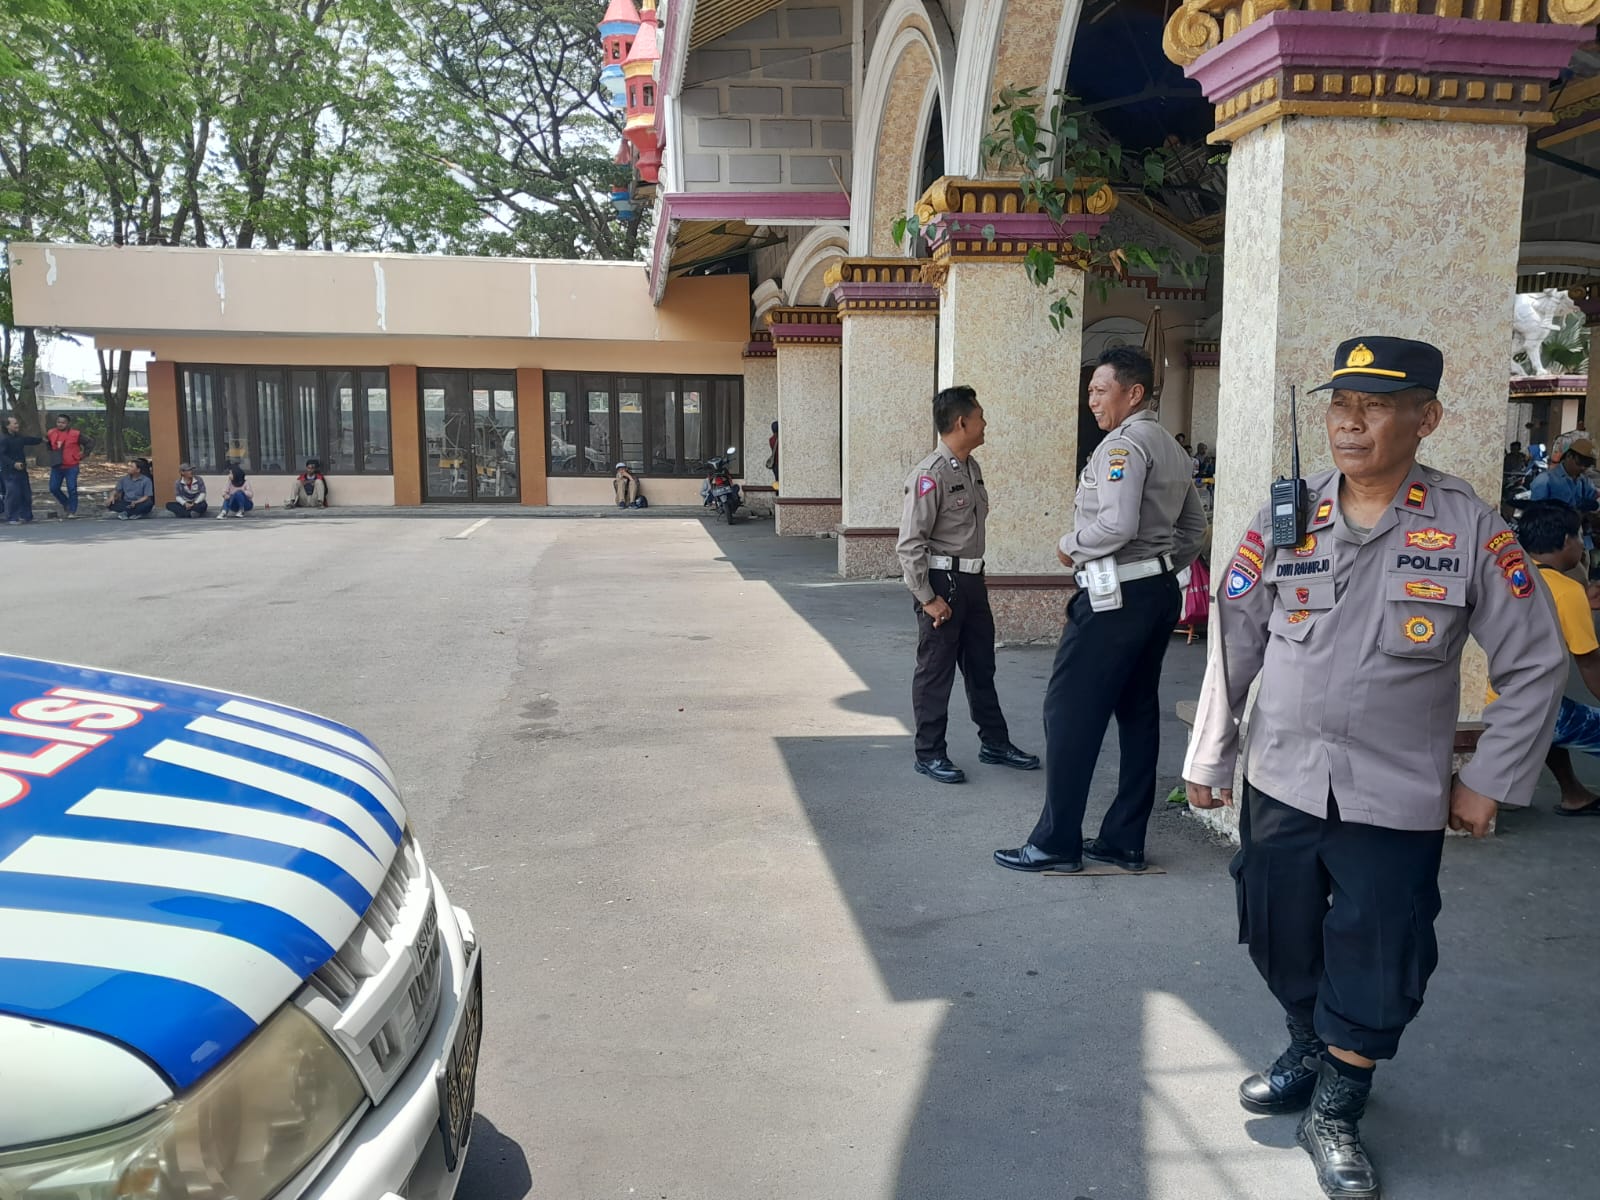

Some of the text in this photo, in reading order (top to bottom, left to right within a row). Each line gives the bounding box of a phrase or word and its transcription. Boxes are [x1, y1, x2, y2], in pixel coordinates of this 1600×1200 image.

[1276, 558, 1330, 577] DWI RAHARJO
[1396, 554, 1460, 573] POLRI
[0, 686, 166, 810] LISI
